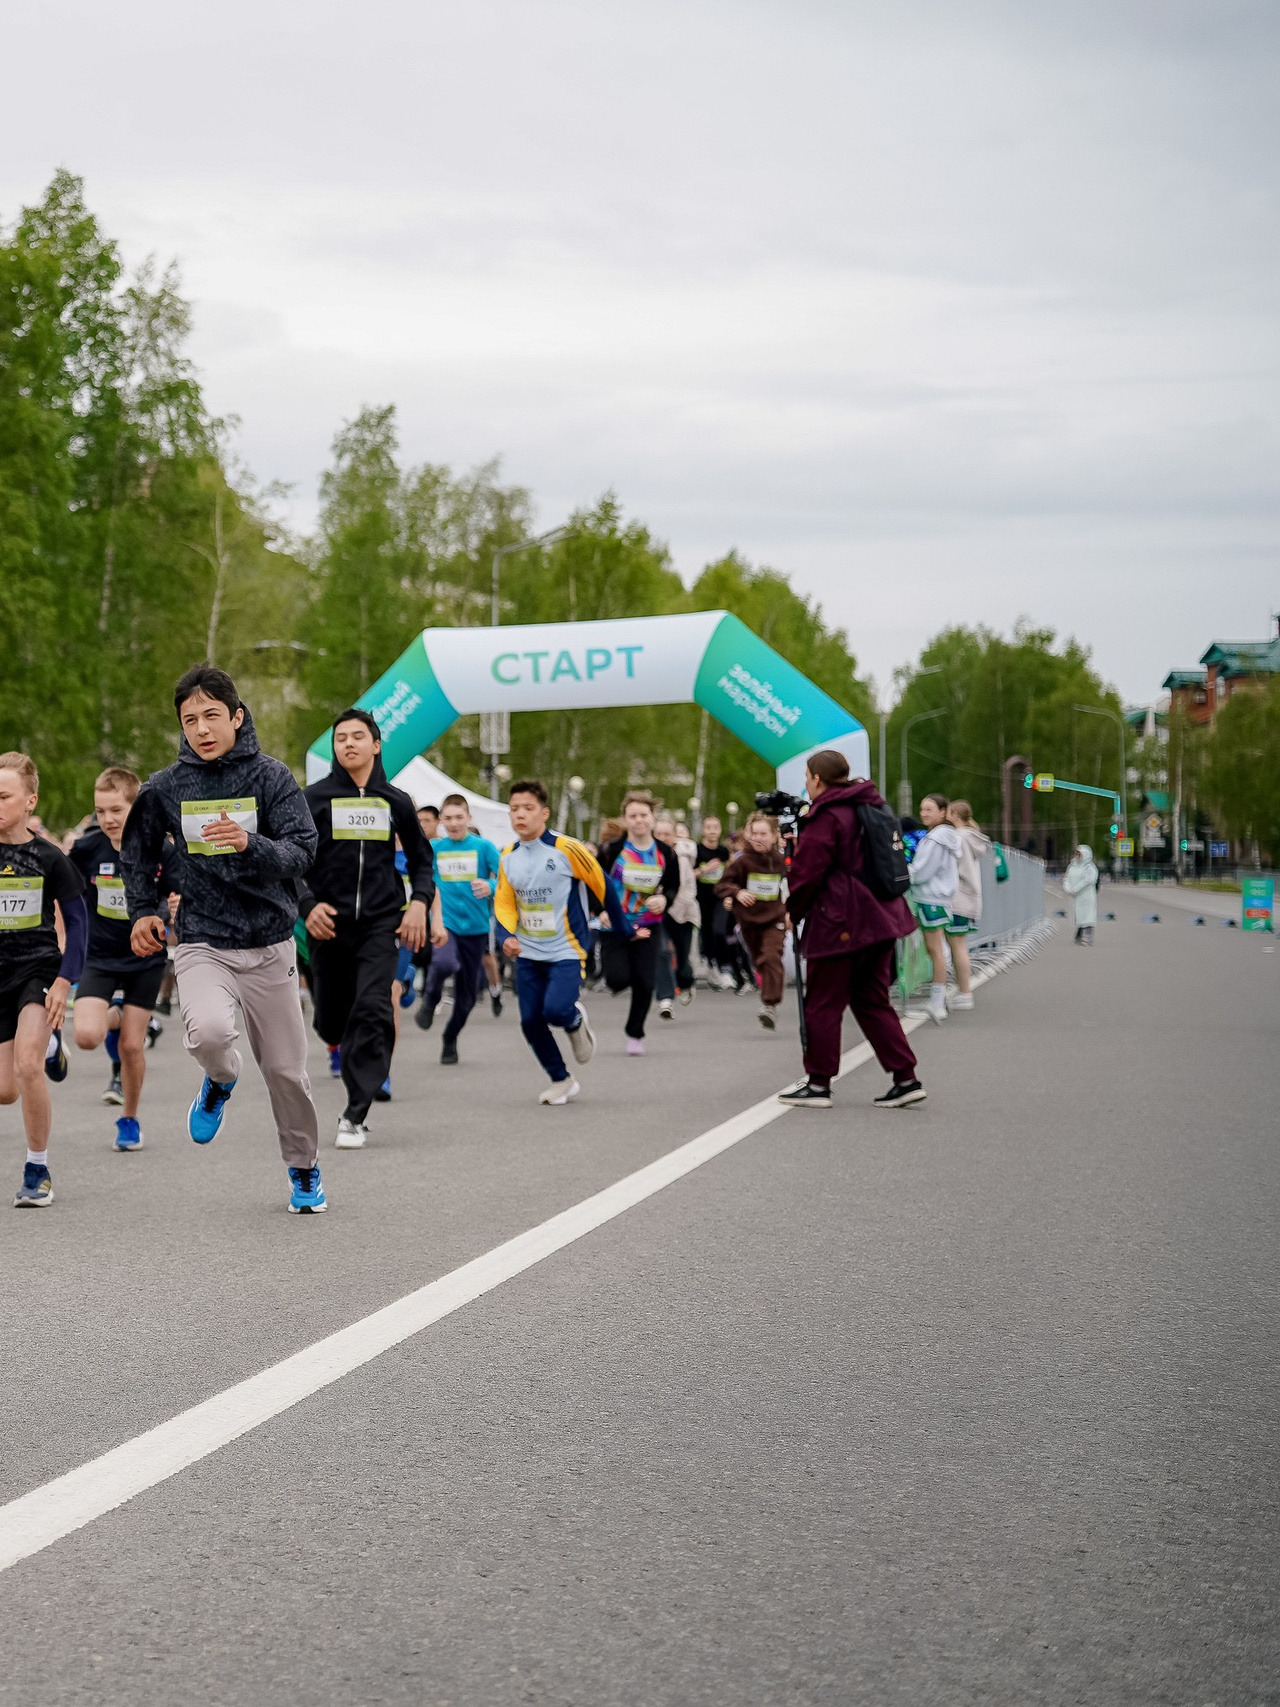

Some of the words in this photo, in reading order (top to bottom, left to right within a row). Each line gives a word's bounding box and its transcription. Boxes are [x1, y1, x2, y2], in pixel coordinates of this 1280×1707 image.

[490, 646, 643, 685] СТАРТ
[348, 815, 375, 825] 3209
[110, 896, 124, 907] 32
